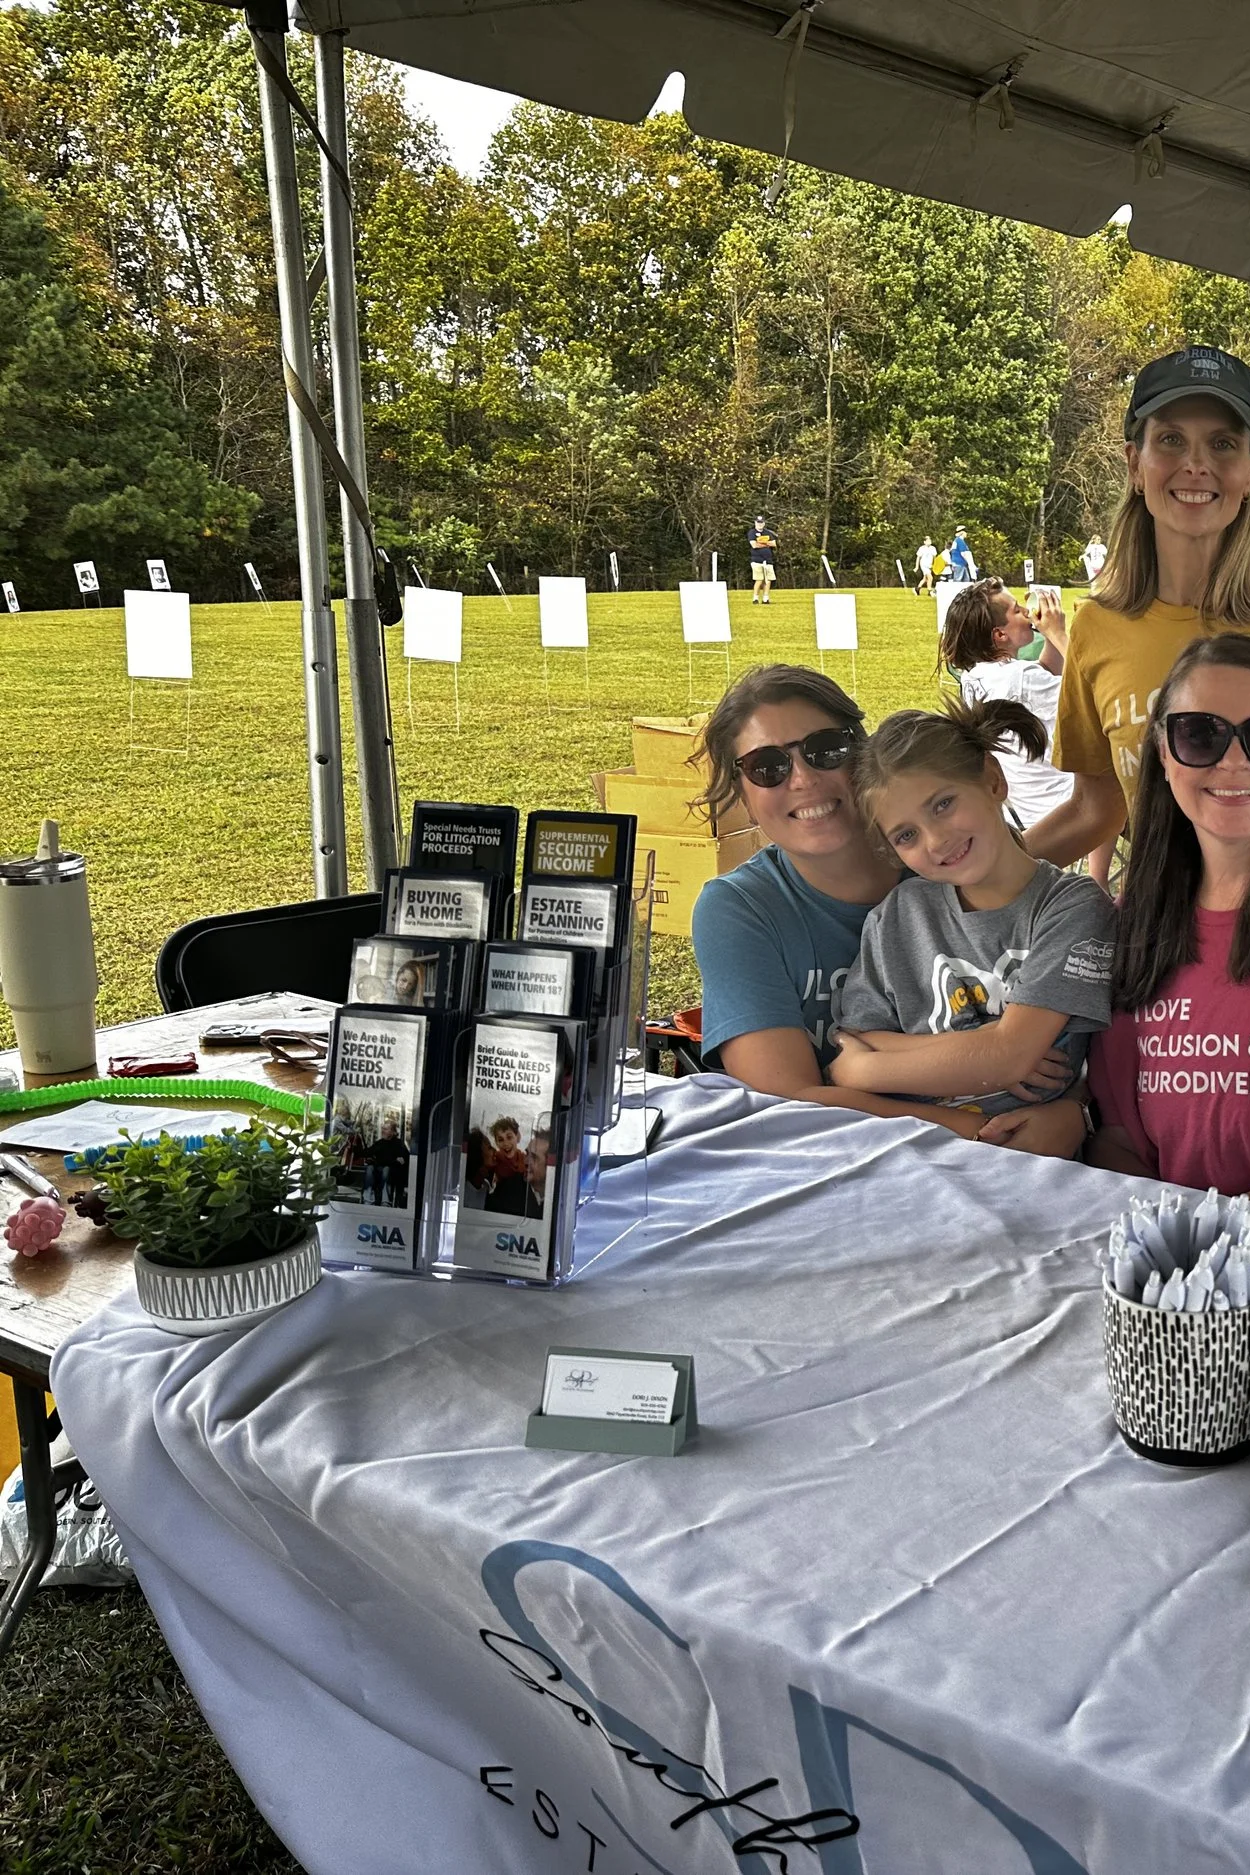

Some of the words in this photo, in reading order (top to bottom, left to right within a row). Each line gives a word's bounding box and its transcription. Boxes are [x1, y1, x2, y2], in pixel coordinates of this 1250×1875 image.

[1191, 368, 1219, 380] LAW
[423, 822, 451, 833] Special
[453, 825, 476, 834] Needs
[478, 826, 501, 835] Trusts
[422, 832, 442, 842] FOR
[445, 834, 500, 846] LITIGATION
[539, 831, 610, 844] SUPPLEMENTAL
[422, 843, 473, 855] PROCEEDS
[538, 842, 608, 858] SECURITY
[537, 857, 595, 873] INCOME
[407, 890, 462, 906] BUYING
[530, 897, 582, 914] ESTATE
[405, 905, 416, 918] A
[420, 906, 463, 921] HOME
[529, 912, 604, 931] PLANNING
[491, 969, 515, 980] WHAT
[517, 971, 557, 983] HAPPENS
[491, 980, 516, 992] WHEN
[522, 983, 545, 993] TURN
[547, 985, 563, 996] 18?
[1144, 998, 1192, 1023] LOVE
[343, 1030, 358, 1042] We
[360, 1032, 378, 1044] Are
[380, 1033, 396, 1045] the
[342, 1043, 394, 1060] SPECIAL
[477, 1044, 495, 1055] Brief
[497, 1047, 519, 1058] Guide
[521, 1050, 529, 1059] to
[340, 1058, 383, 1074] NEEDS
[476, 1054, 515, 1069] SPECIAL
[518, 1058, 551, 1073] NEEDS
[475, 1066, 511, 1080] TRUSTS
[513, 1069, 540, 1084] (SNT)
[475, 1077, 494, 1089] FOR
[496, 1080, 541, 1095] FAMILIES
[357, 1223, 406, 1246] SNA
[495, 1232, 541, 1257] SNA
